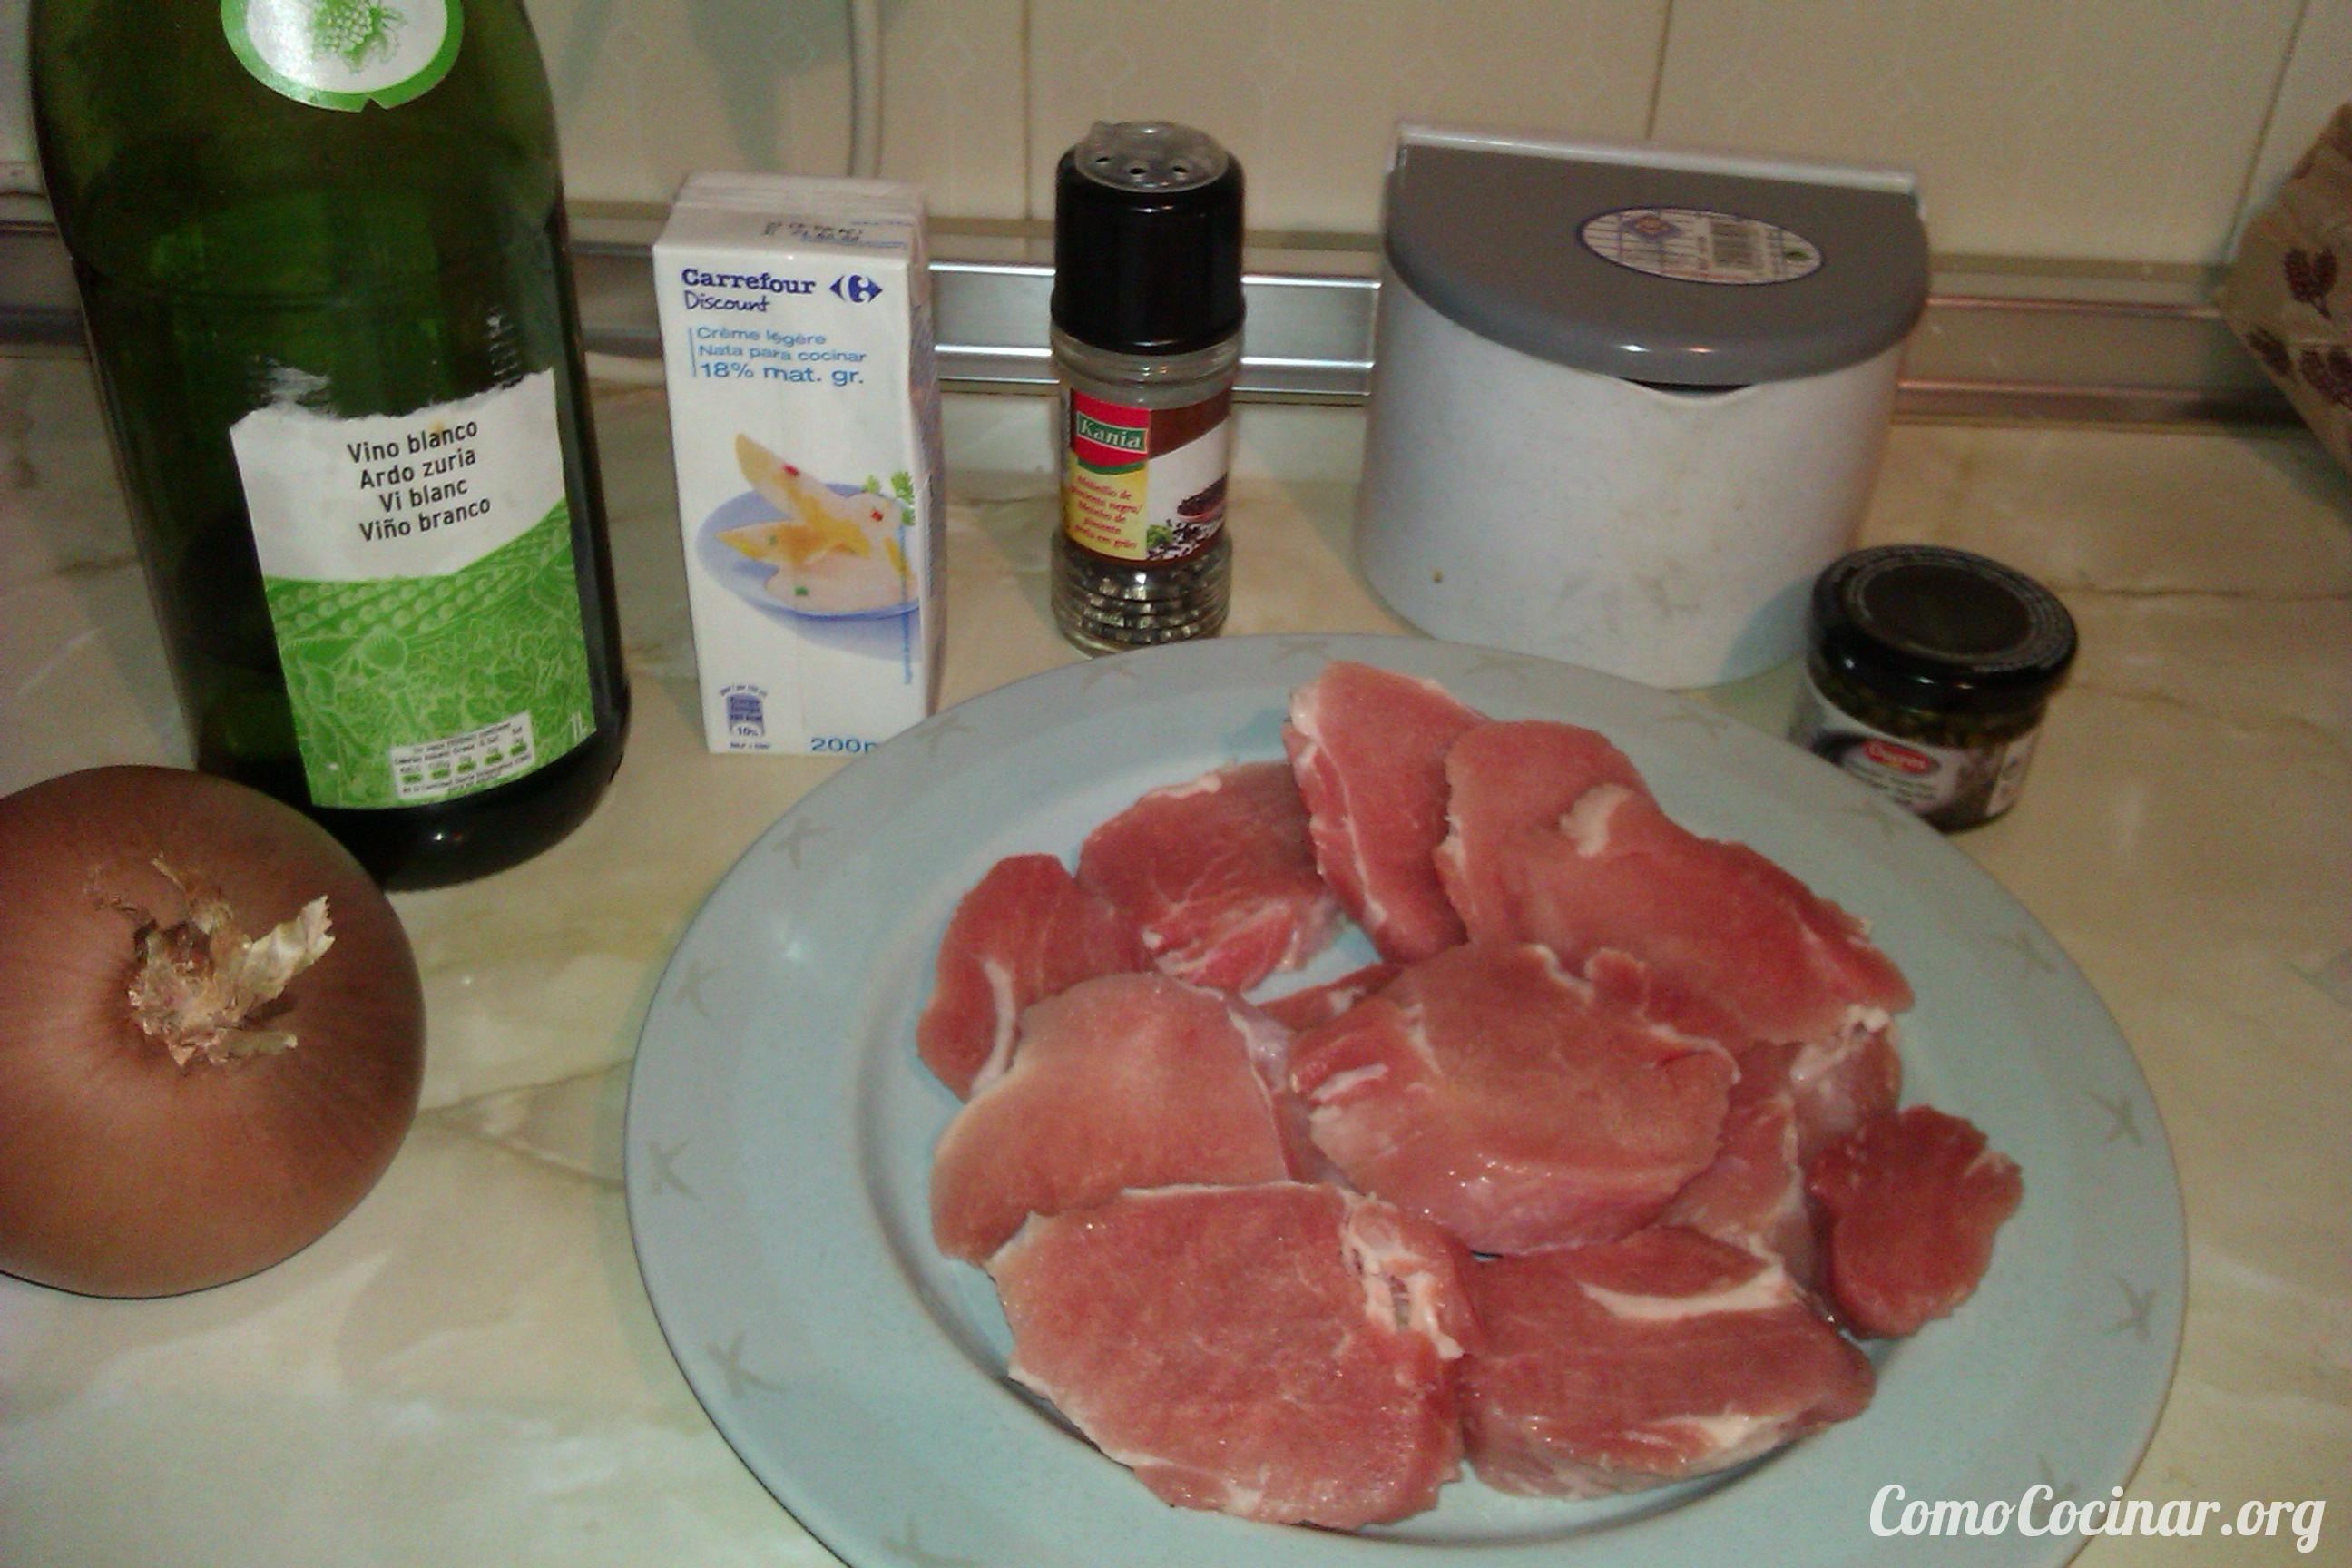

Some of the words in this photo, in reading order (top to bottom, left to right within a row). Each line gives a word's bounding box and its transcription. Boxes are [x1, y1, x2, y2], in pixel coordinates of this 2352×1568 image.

[681, 268, 816, 294] Carrefour
[683, 290, 770, 312] Discount
[697, 327, 760, 340] Crème
[699, 345, 743, 357] Nata
[750, 348, 791, 361] para
[798, 350, 867, 362] cocinar
[701, 362, 754, 378] 18%
[763, 367, 822, 382] mat.
[831, 369, 864, 387] gr.
[347, 441, 400, 464] Vino
[407, 421, 477, 454] blanco
[1081, 420, 1141, 448] Kania
[360, 465, 415, 490] Ardo
[422, 448, 476, 477] zuria
[379, 491, 402, 513] Vi
[409, 479, 468, 507] blanc
[359, 518, 411, 542] Viño
[418, 498, 491, 533] branco
